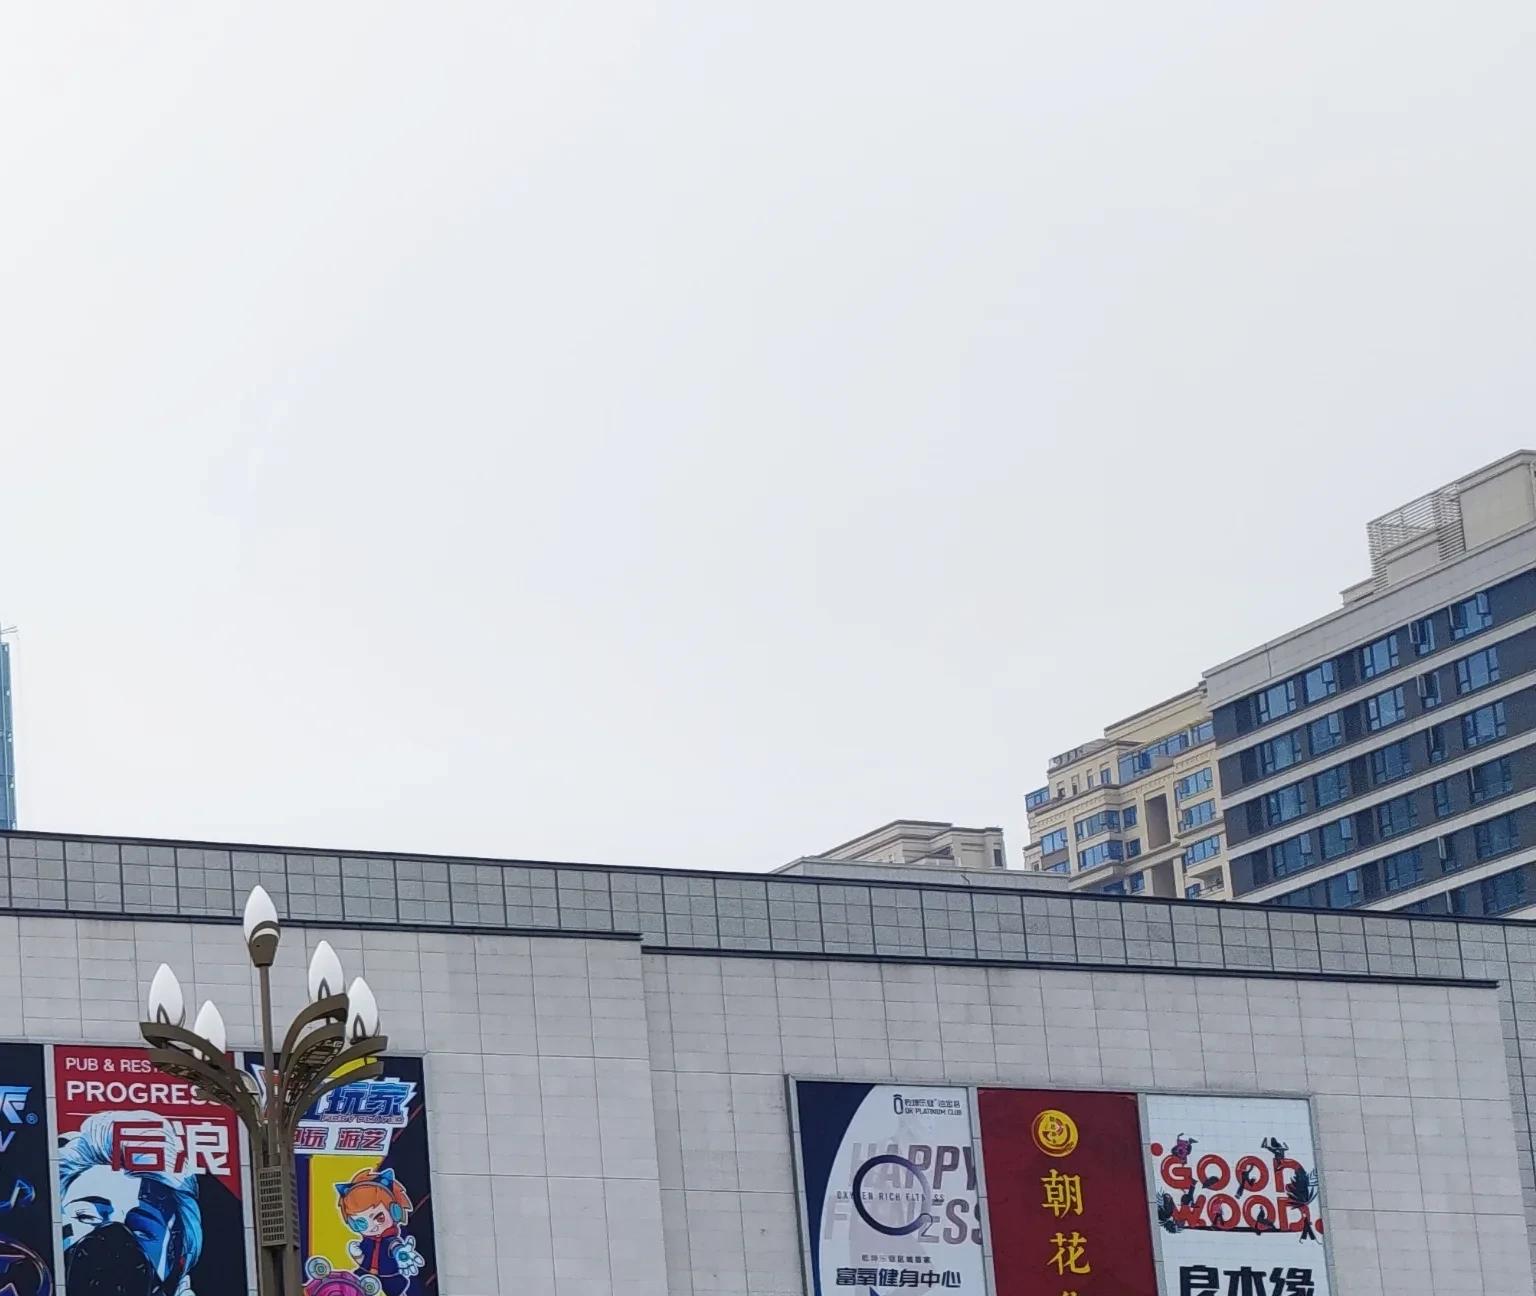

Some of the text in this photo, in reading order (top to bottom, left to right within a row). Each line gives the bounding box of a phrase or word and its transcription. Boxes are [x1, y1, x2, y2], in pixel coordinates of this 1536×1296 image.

[65, 1058, 98, 1071] PUB
[103, 1059, 115, 1072] &
[335, 1127, 388, 1151] 游艺
[1160, 1153, 1308, 1192] GOOD
[878, 1192, 901, 1201] RICH
[1169, 1193, 1311, 1232] WOOD
[836, 1267, 961, 1288] 富氧健身中心
